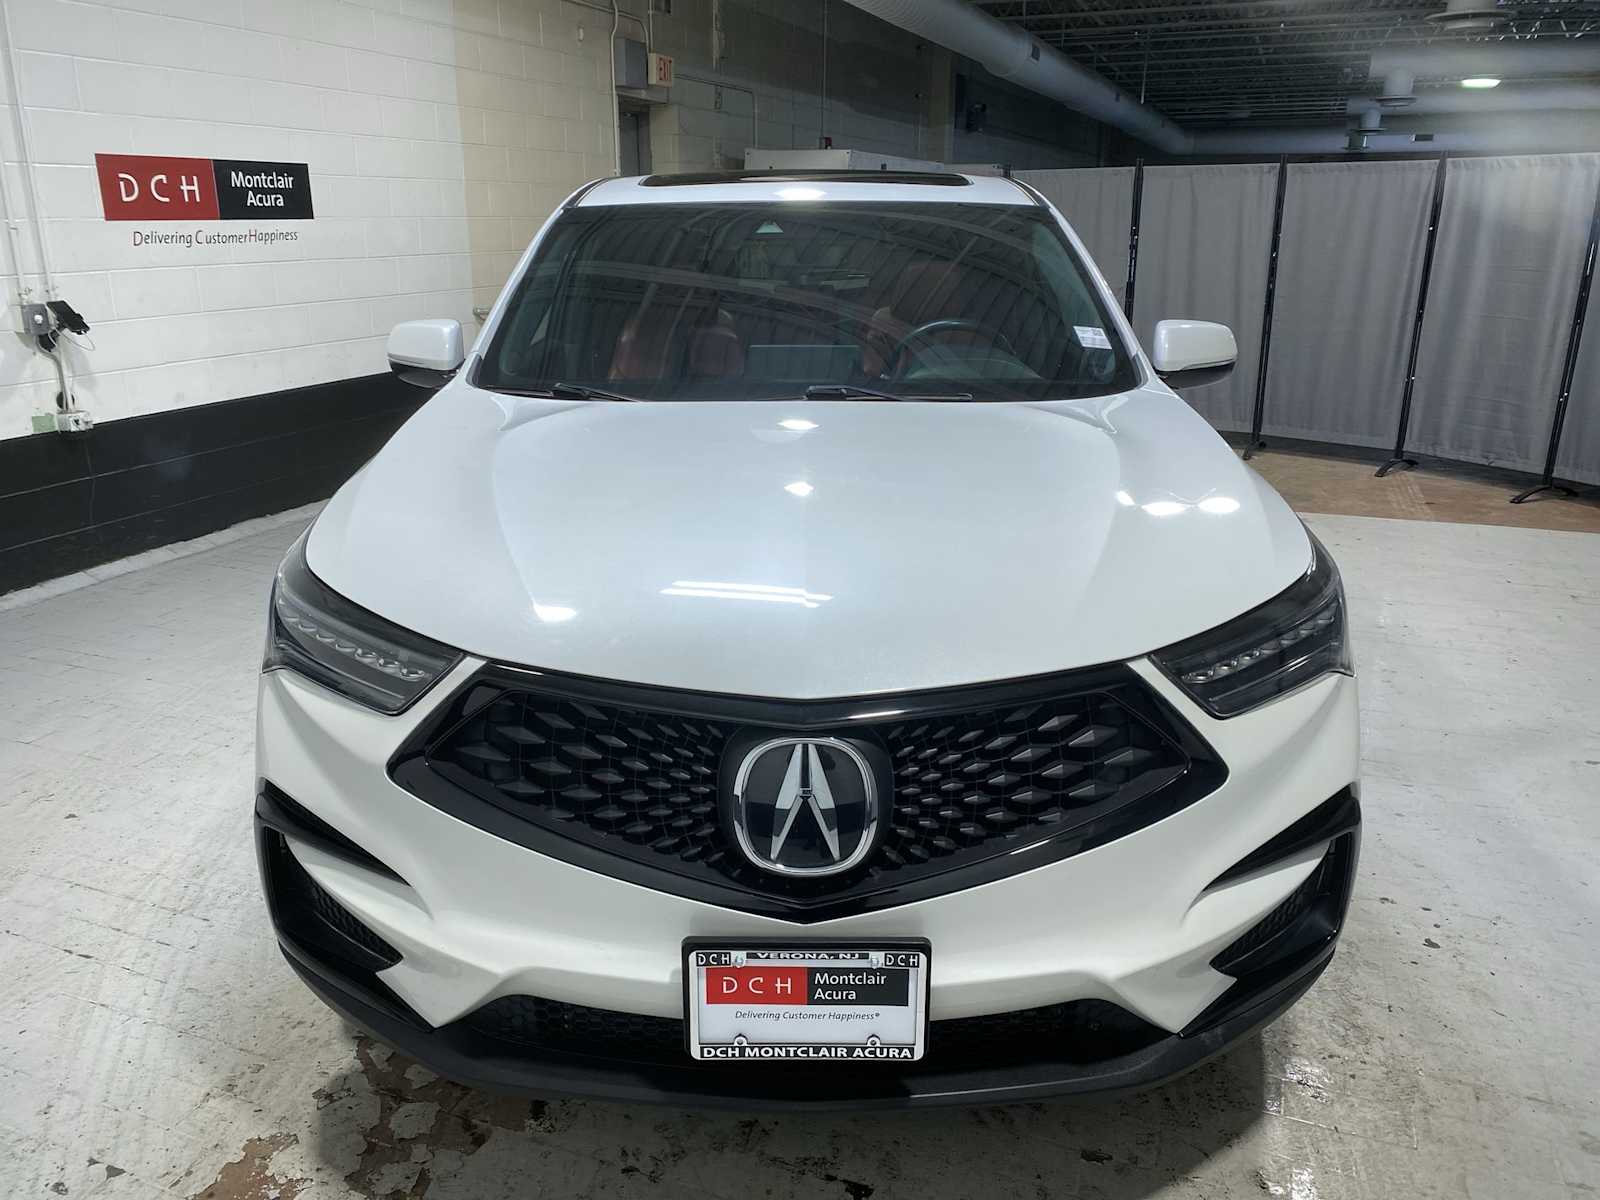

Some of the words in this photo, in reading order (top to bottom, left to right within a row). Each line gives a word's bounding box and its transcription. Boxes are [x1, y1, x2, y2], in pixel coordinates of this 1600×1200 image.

[659, 57, 673, 81] EXIT
[231, 171, 295, 190] Montclair
[246, 190, 285, 208] Acura
[133, 231, 193, 248] Delivering
[838, 952, 860, 960] NJ
[814, 971, 887, 985] Montclair
[814, 988, 856, 1000] Acura
[735, 1010, 780, 1021] Delivering
[782, 1011, 827, 1020] Customer
[703, 1047, 740, 1058] DCH
[744, 1047, 849, 1059] MONTCLAIR
[854, 1047, 912, 1059] ACURA
